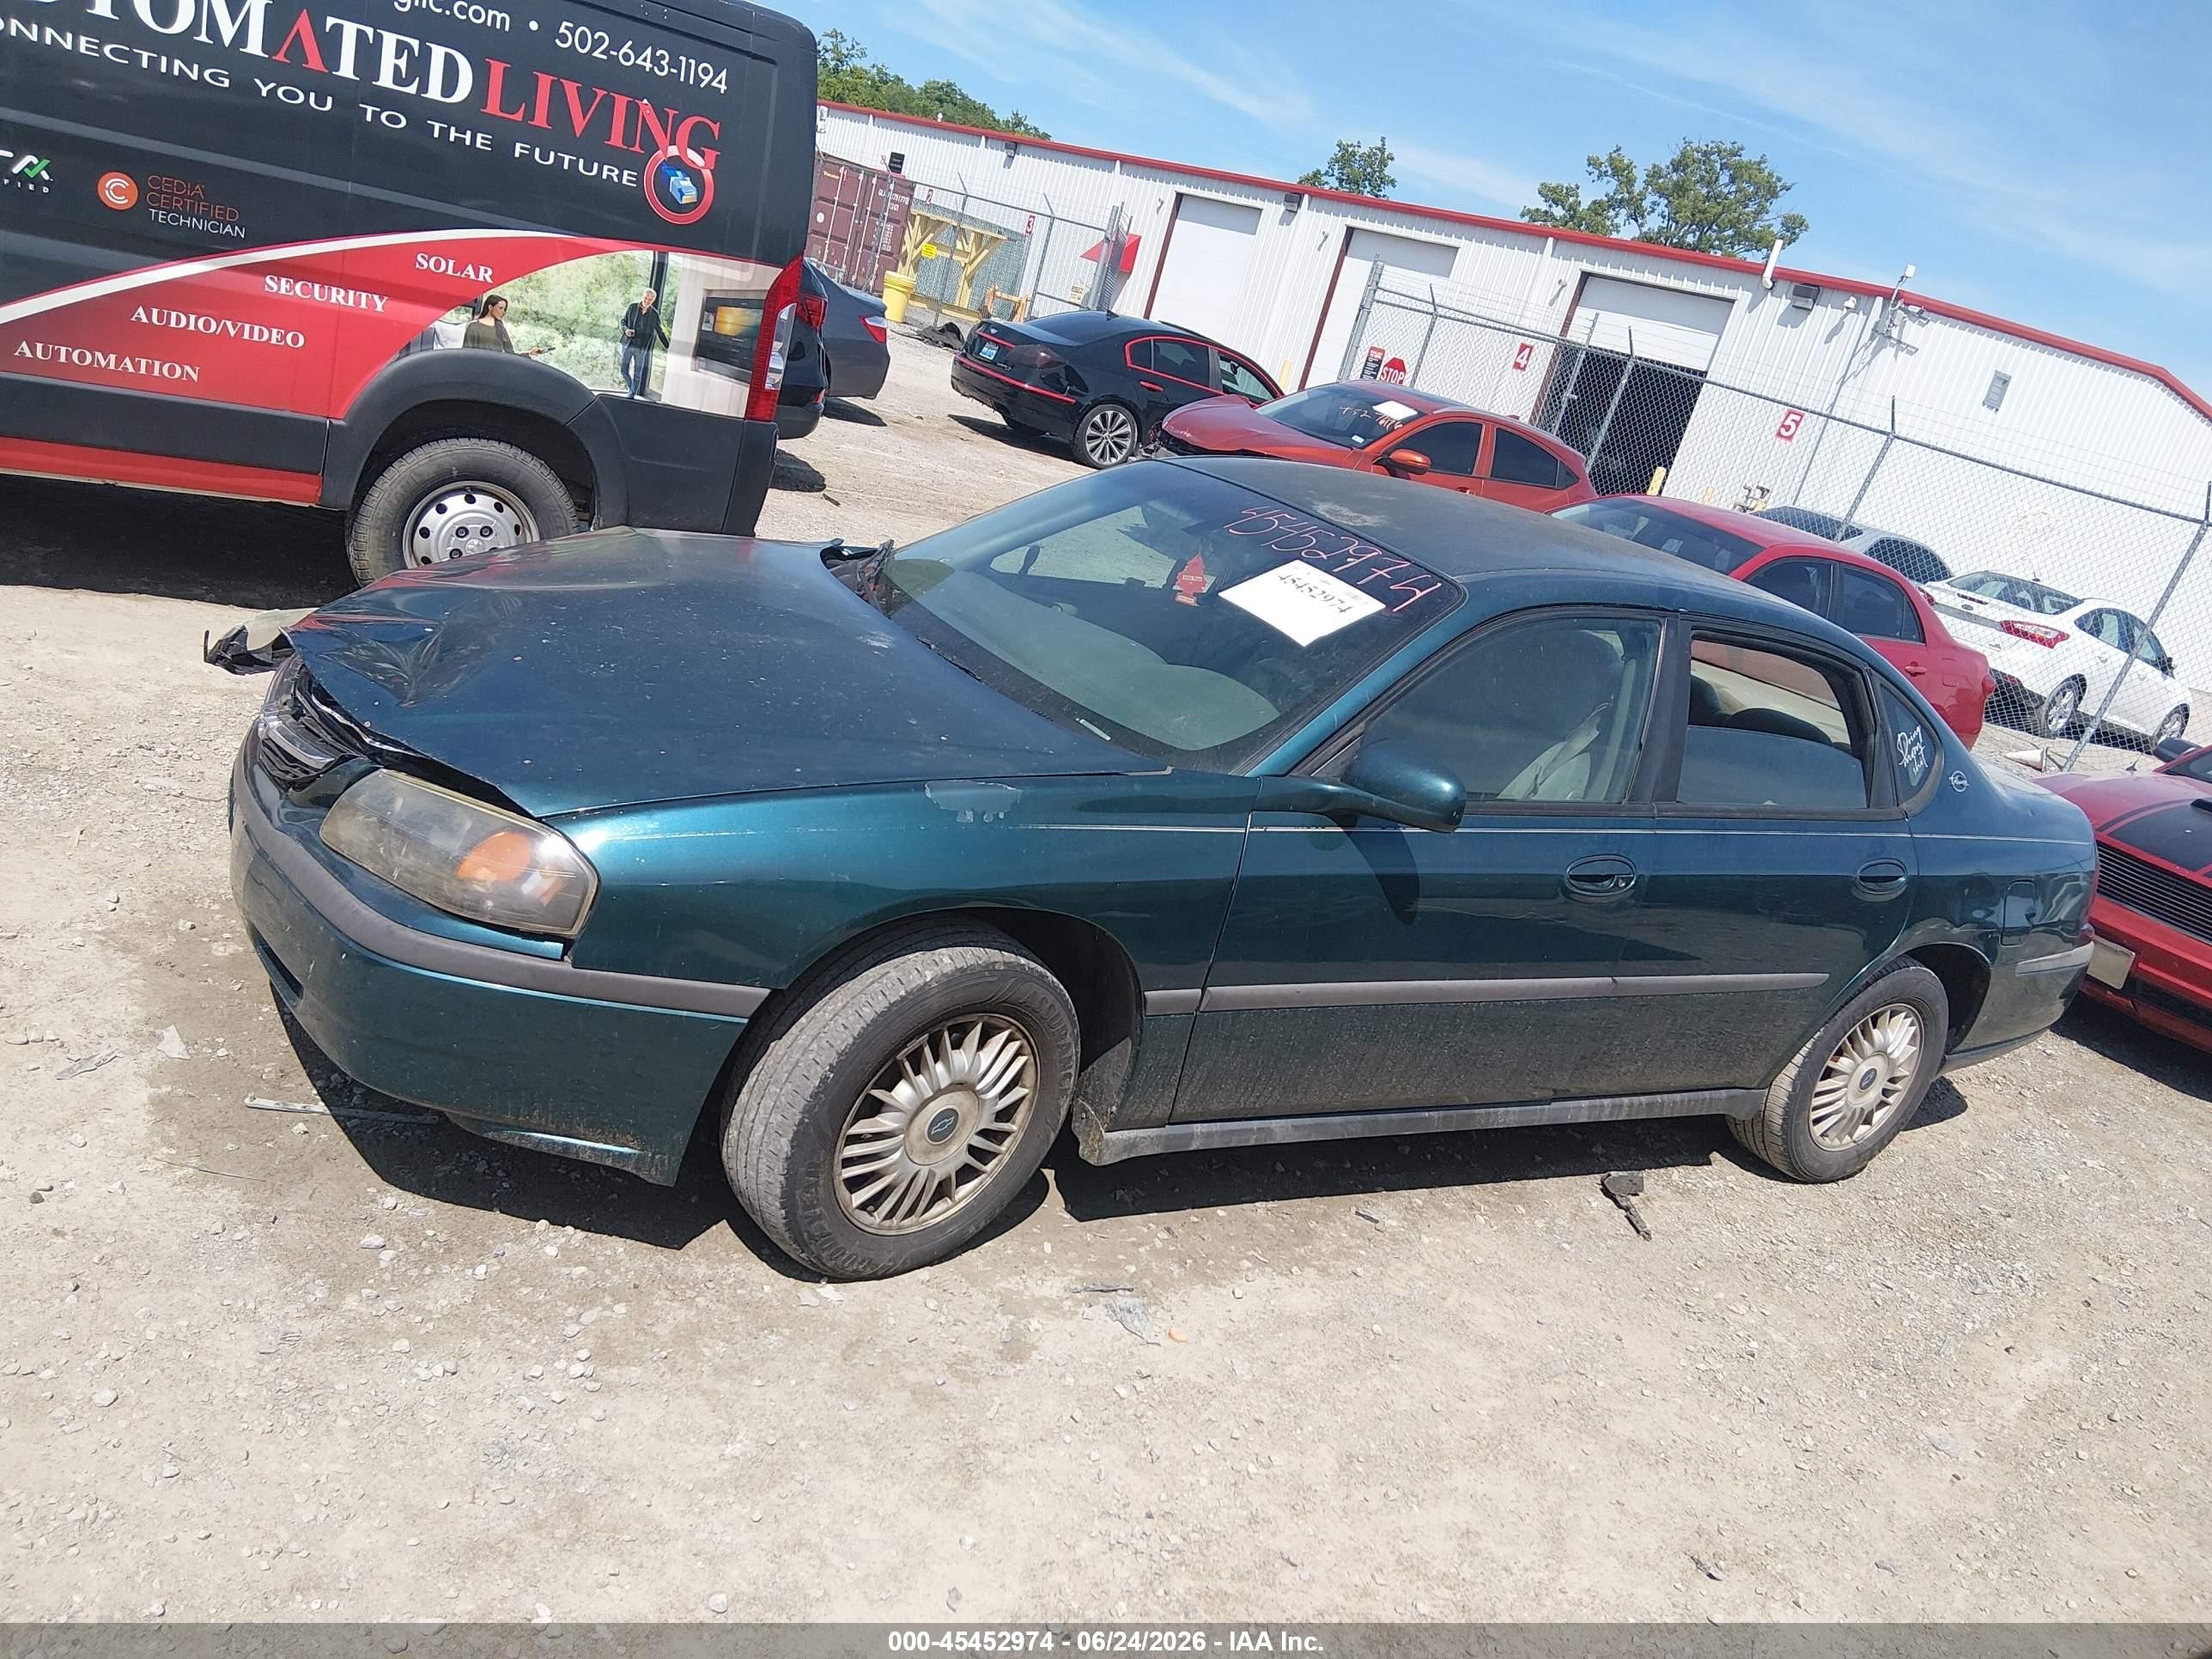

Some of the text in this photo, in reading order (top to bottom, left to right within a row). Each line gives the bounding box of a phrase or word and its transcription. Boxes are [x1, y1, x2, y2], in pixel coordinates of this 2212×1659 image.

[555, 21, 728, 94] 502-643-1194
[0, 16, 639, 188] NNECTING YOU TO THE FUTURE
[38, 0, 721, 172] OMATED LIVING
[147, 174, 205, 198] CEDIA
[146, 191, 240, 222] CERTIFIED
[148, 208, 247, 239] TECHNICIAN
[1026, 216, 1035, 233] 3
[414, 252, 495, 284] SOLAR
[264, 275, 389, 313] SECURITY
[131, 305, 306, 349] AUDIO/VIDEO
[14, 340, 201, 384] AUTOMATION
[1516, 347, 1531, 368] 4
[1381, 366, 1405, 386] STOP
[1780, 413, 1802, 437] 5
[1223, 507, 1443, 611] 45452974
